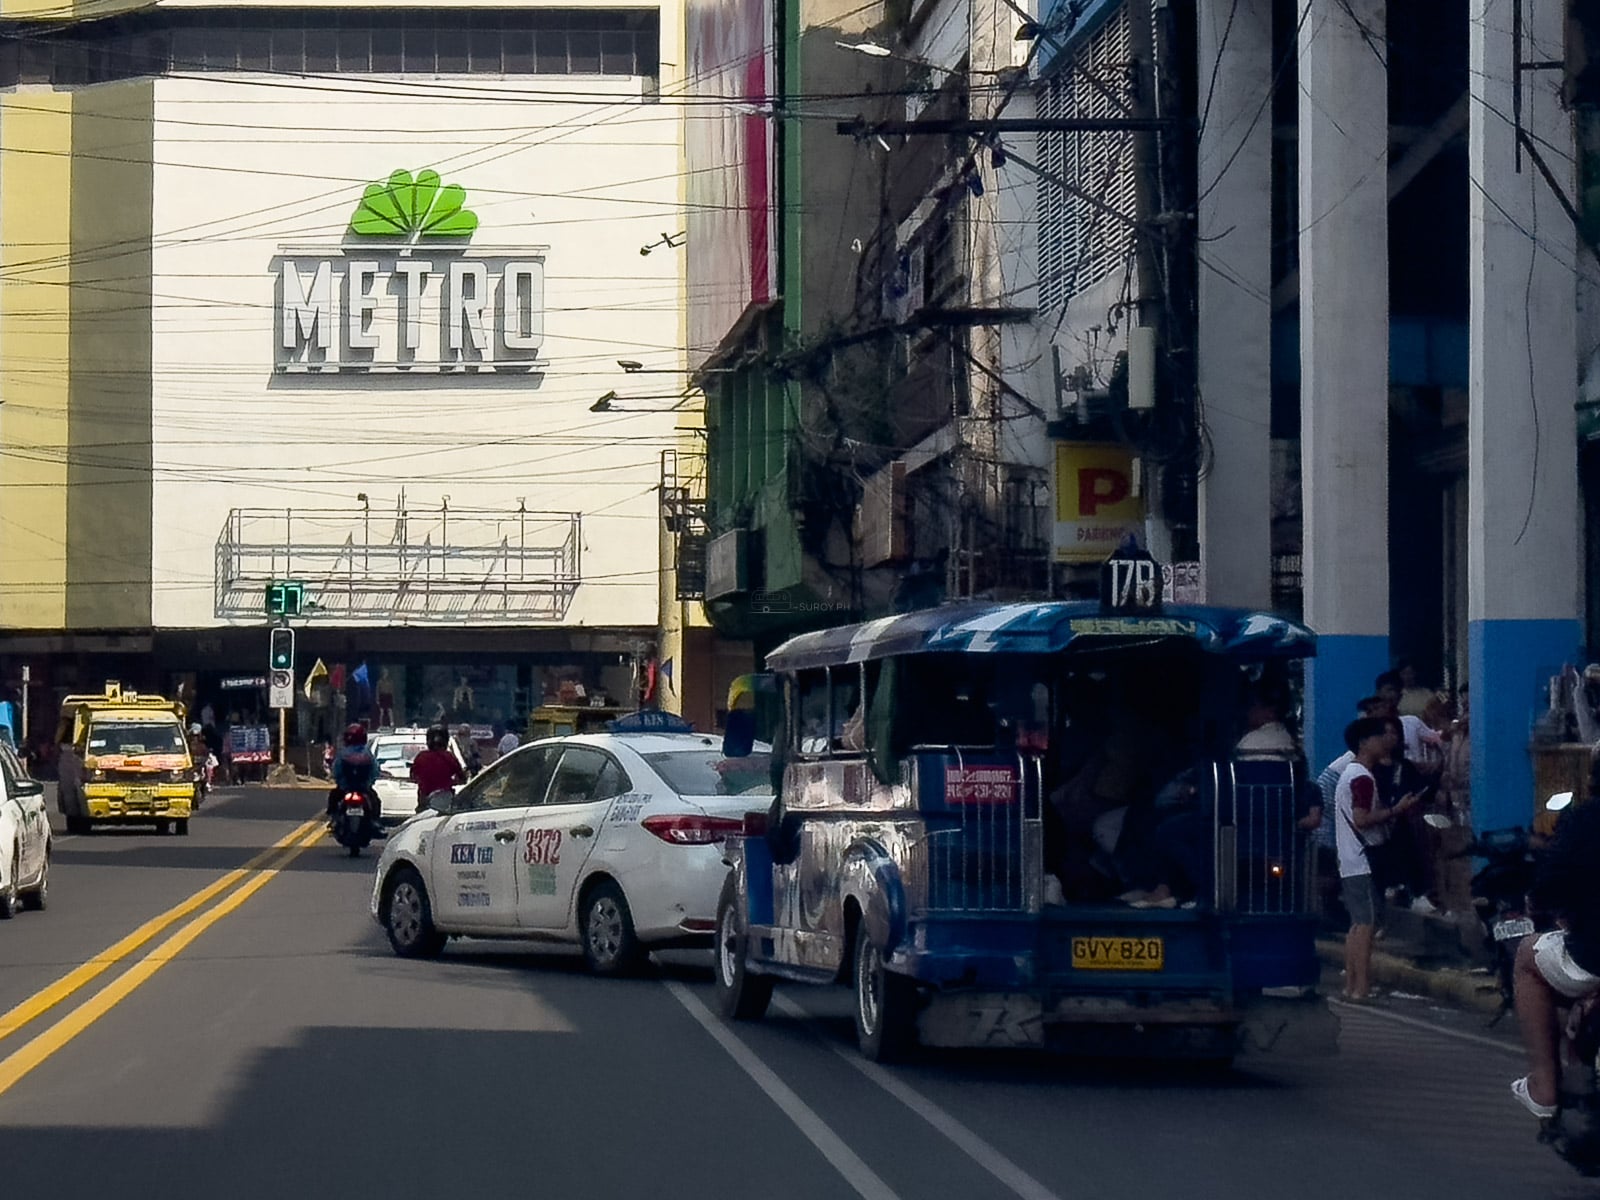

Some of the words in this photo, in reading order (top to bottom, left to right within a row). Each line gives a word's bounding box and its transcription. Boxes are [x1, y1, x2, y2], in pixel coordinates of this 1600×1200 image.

[283, 260, 545, 350] METRO
[1077, 468, 1129, 516] P
[270, 586, 302, 614] 37
[450, 843, 476, 865] KEN
[523, 828, 562, 866] 3372
